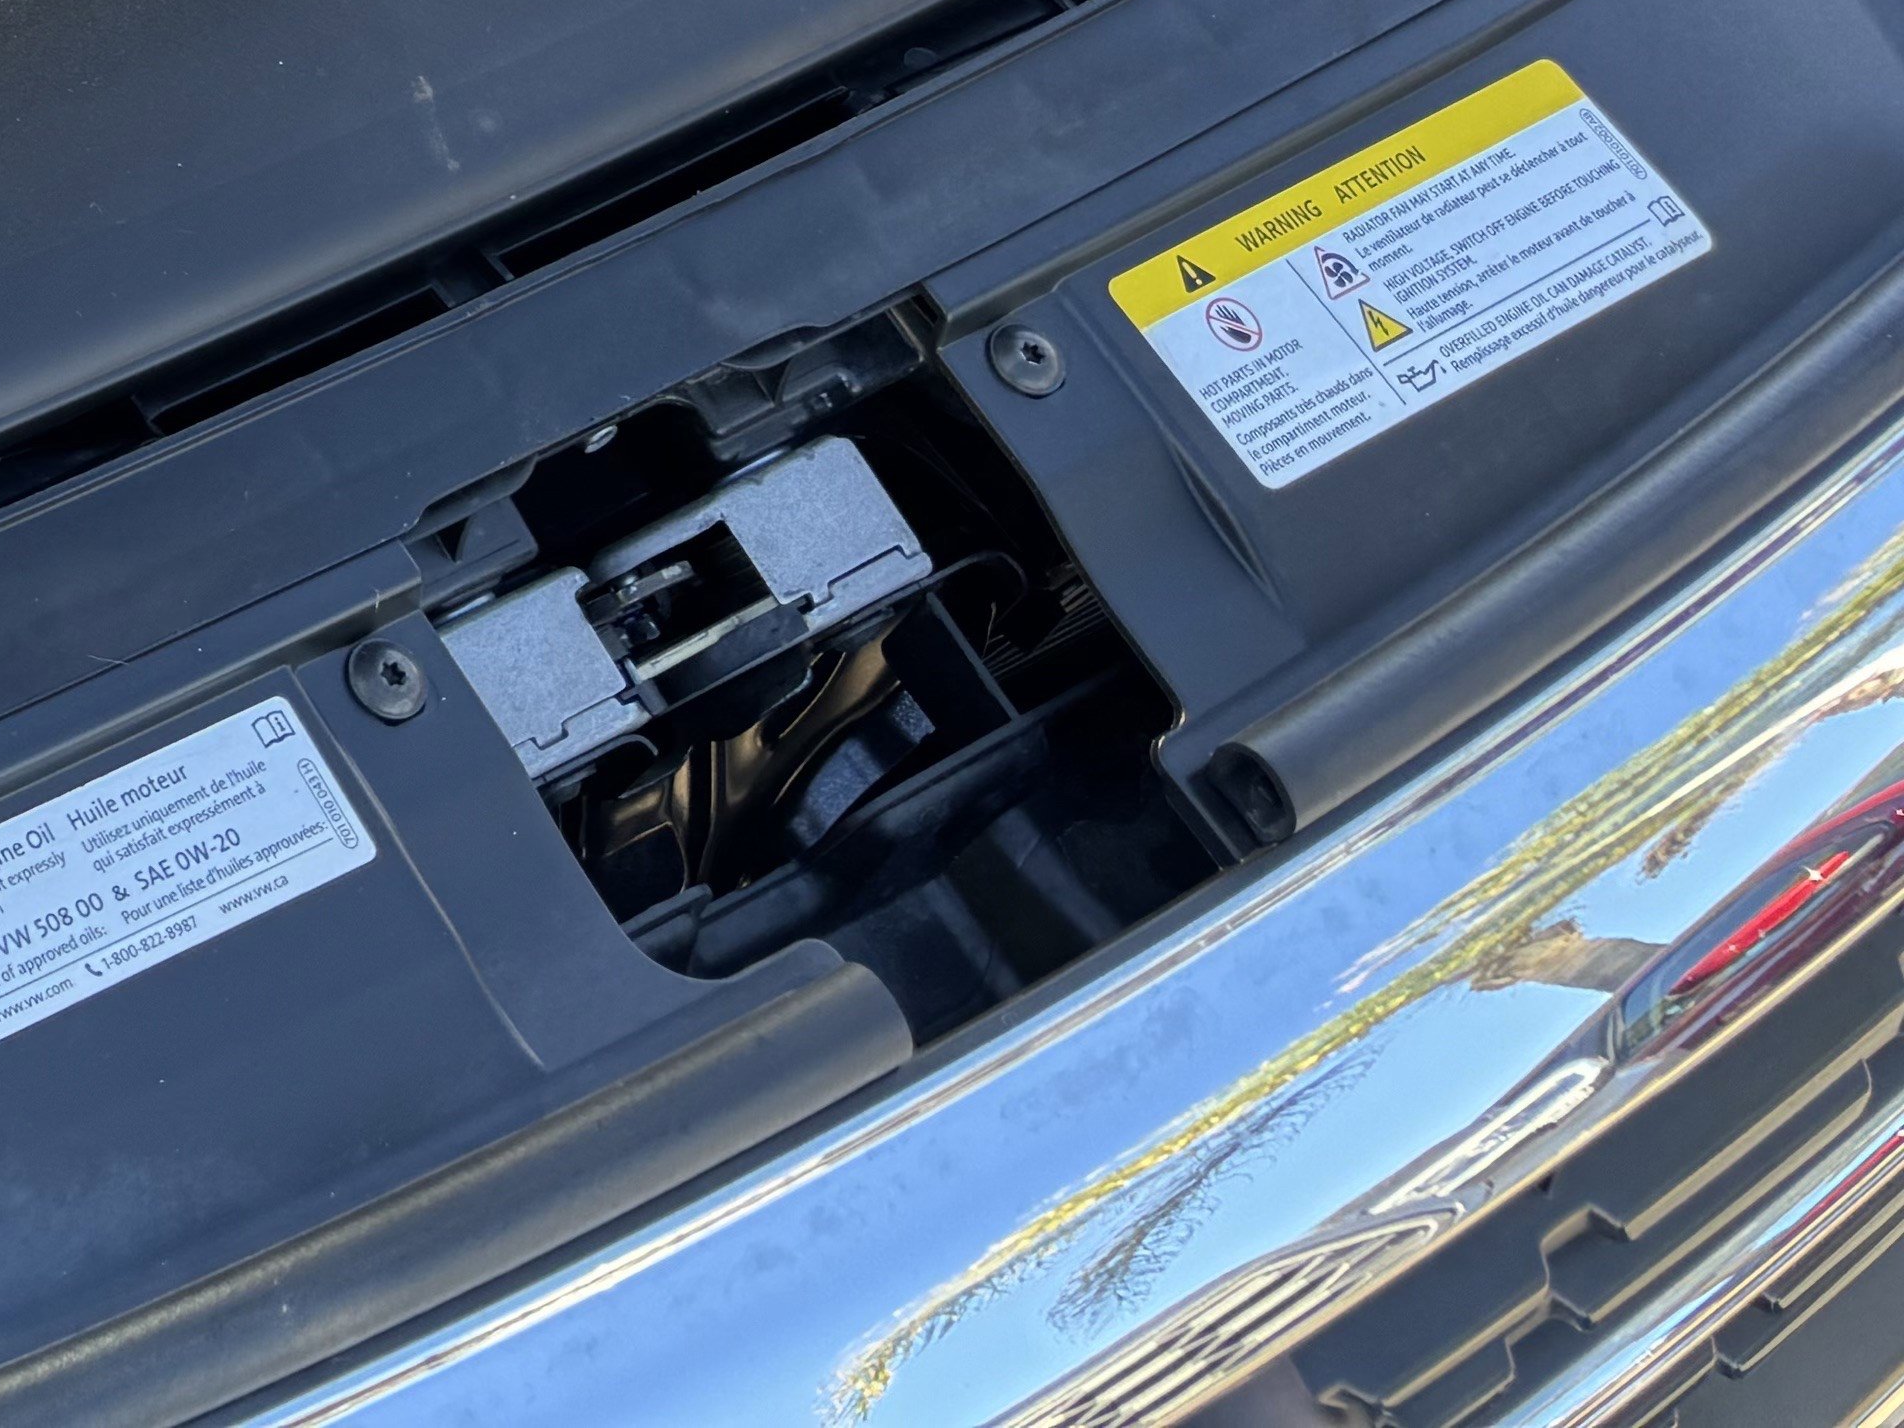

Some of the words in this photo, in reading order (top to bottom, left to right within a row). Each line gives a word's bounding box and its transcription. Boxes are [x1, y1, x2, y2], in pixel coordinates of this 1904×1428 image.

[1234, 198, 1323, 254] WARNING
[1333, 145, 1428, 206] ATTENTION
[1342, 211, 1393, 243] RADIATOR
[1389, 201, 1412, 219] FAN
[1408, 190, 1432, 208] MAY
[1428, 175, 1460, 198] START
[1457, 168, 1472, 183] AT
[1469, 159, 1491, 177] ANY
[1487, 147, 1516, 166] TIME.
[1354, 246, 1372, 259] Le
[1368, 219, 1422, 251] ventilateur
[1420, 212, 1435, 225] de
[1433, 189, 1477, 218] radiateur
[1476, 177, 1501, 198] peut
[1498, 172, 1512, 184] se
[1510, 146, 1559, 177] déclencher
[1556, 141, 1568, 152] à
[1564, 131, 1588, 148] tout
[1382, 271, 1410, 292] HIGH
[1405, 249, 1454, 277] VOLTAGE,
[1449, 229, 1489, 255] SWITCH
[1485, 218, 1505, 236] OFF
[1503, 201, 1542, 226] ENGINE
[1537, 182, 1576, 208] BEFORE
[1571, 158, 1621, 188] TOUCHING
[1368, 244, 1413, 272] moment.
[1393, 273, 1439, 305] IGNITION
[1435, 254, 1478, 281] SYSTEM.
[1406, 298, 1440, 320] Haute
[1436, 279, 1480, 304] tension,
[1476, 259, 1510, 283] arrêter
[1505, 254, 1521, 265] le
[1518, 235, 1554, 260] moteur
[1552, 221, 1582, 242] avant
[1578, 214, 1594, 227] de
[1590, 195, 1628, 220] toucher
[1624, 190, 1636, 202] à
[1416, 300, 1474, 333] l'allumage.
[1439, 320, 1497, 358] OVERFILLED
[1494, 300, 1533, 327] ENGINE
[1530, 292, 1550, 308] OIL
[1546, 280, 1570, 298] CAN
[1565, 259, 1608, 288] DAMAGE
[1605, 236, 1652, 266] CATALYST.
[1449, 335, 1512, 372] Remplissage
[1510, 311, 1548, 340] excessif
[1546, 297, 1580, 321] d'huile
[1577, 271, 1627, 304] dangereux
[1623, 260, 1647, 281] pour
[1643, 255, 1657, 266] le
[1198, 380, 1223, 400] HOT
[1219, 363, 1255, 388] PARTS
[1251, 357, 1267, 371] IN
[1263, 338, 1303, 365] MOTOR
[1210, 366, 1289, 413] COMPARTMENT.
[1221, 398, 1265, 428] MOVING
[1261, 381, 1299, 406] PARTS.
[1235, 408, 1298, 445] Composants
[1294, 398, 1317, 414] très
[1314, 379, 1350, 404] chauds
[1348, 367, 1373, 386] dans
[1247, 449, 1262, 461] le
[1260, 410, 1332, 455] compartiment
[1329, 391, 1371, 417] moteur.
[1259, 452, 1295, 476] Pièces
[1294, 445, 1310, 458] en
[1307, 411, 1371, 451] mouvement.
[66, 797, 119, 831] Huile
[120, 765, 187, 807] moteur
[300, 762, 313, 774] H
[307, 774, 328, 800] 043
[25, 822, 55, 849] Oil
[80, 823, 132, 853] Utilisez
[131, 785, 210, 831] uniquement
[210, 779, 228, 794] de
[225, 760, 267, 786] l'huile
[92, 850, 115, 872] qui
[115, 827, 168, 861] satisfait
[162, 785, 256, 836] expressément
[254, 780, 266, 795] à
[322, 799, 343, 823] 010
[337, 822, 355, 844] 701
[7, 851, 66, 886] expressly
[33, 906, 74, 938] 508
[74, 892, 104, 918] 00
[111, 885, 130, 902] &
[133, 858, 175, 891] SAE
[174, 827, 240, 871] 0W-20
[120, 902, 152, 925] Pour
[152, 890, 179, 910] une
[176, 877, 207, 898] liste
[205, 854, 254, 885] d'huiles
[253, 821, 328, 862] approuvées:
[218, 875, 289, 914] www.vw.ca
[1, 963, 16, 982] of
[16, 934, 79, 975] approved
[79, 925, 107, 945] oils:
[101, 914, 197, 969] 1-800-822-8987
